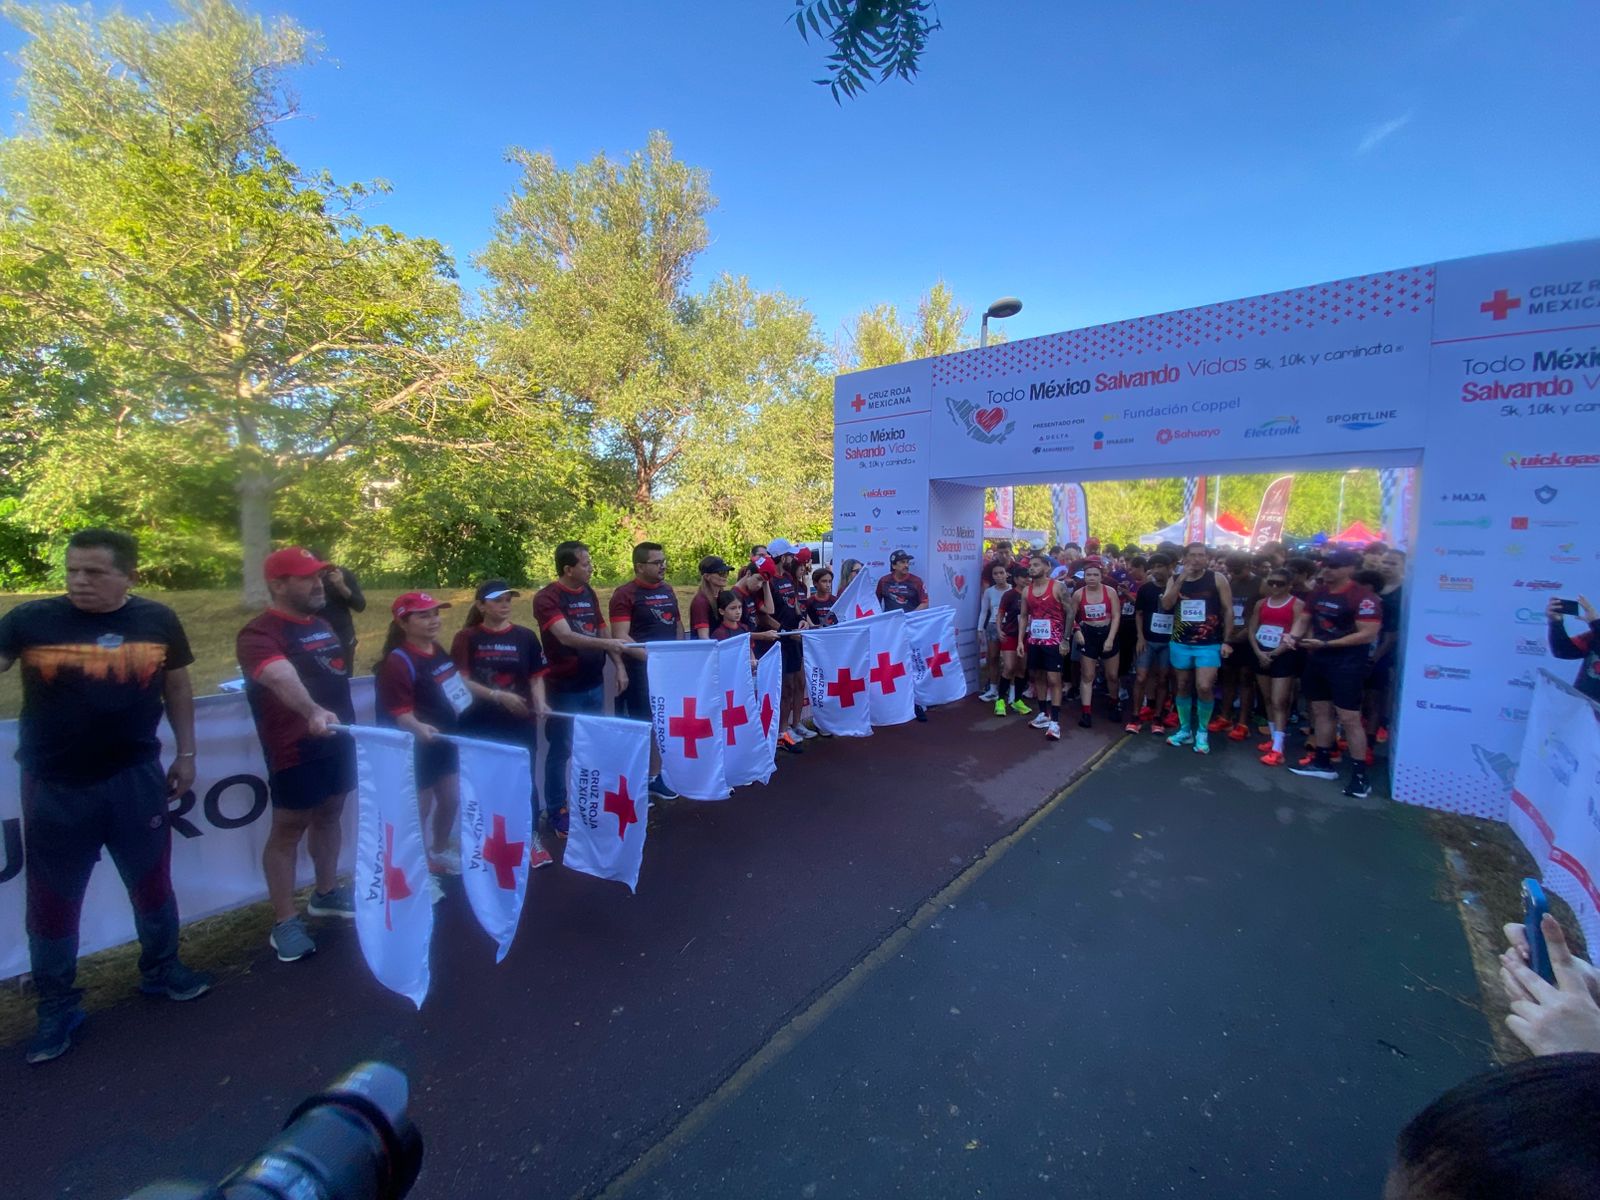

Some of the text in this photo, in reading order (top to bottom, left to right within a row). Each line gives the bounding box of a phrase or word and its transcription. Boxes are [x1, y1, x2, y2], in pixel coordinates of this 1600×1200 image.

[1529, 281, 1583, 299] CRUZ
[1529, 296, 1600, 315] MEXIC
[987, 387, 1025, 405] Todo
[1029, 378, 1091, 401] México
[1095, 364, 1180, 393] Salvando
[1187, 357, 1247, 377] Vidas
[1279, 353, 1306, 368] 10k
[1310, 353, 1321, 366] y
[1323, 342, 1393, 362] caminata
[1462, 355, 1526, 375] Todo
[868, 386, 912, 400] CRUZ ROJA
[1461, 375, 1574, 403] Salvando
[868, 396, 912, 409] MEXICANA
[1123, 397, 1241, 419] Fundación Coppel
[1527, 402, 1556, 416] 10k
[1560, 403, 1571, 416] y
[1032, 420, 1071, 429] PRESENTADO
[1326, 409, 1398, 424] SPORTLINE
[845, 427, 905, 444] Todo México
[1173, 428, 1221, 440] Sahuayo
[1244, 424, 1301, 438] Electrolit
[845, 442, 917, 460] Salvando Vidas
[1452, 493, 1487, 502] MAJA
[657, 696, 666, 754] CRUZ ROJA
[588, 769, 600, 829] CRUZ ROJA
